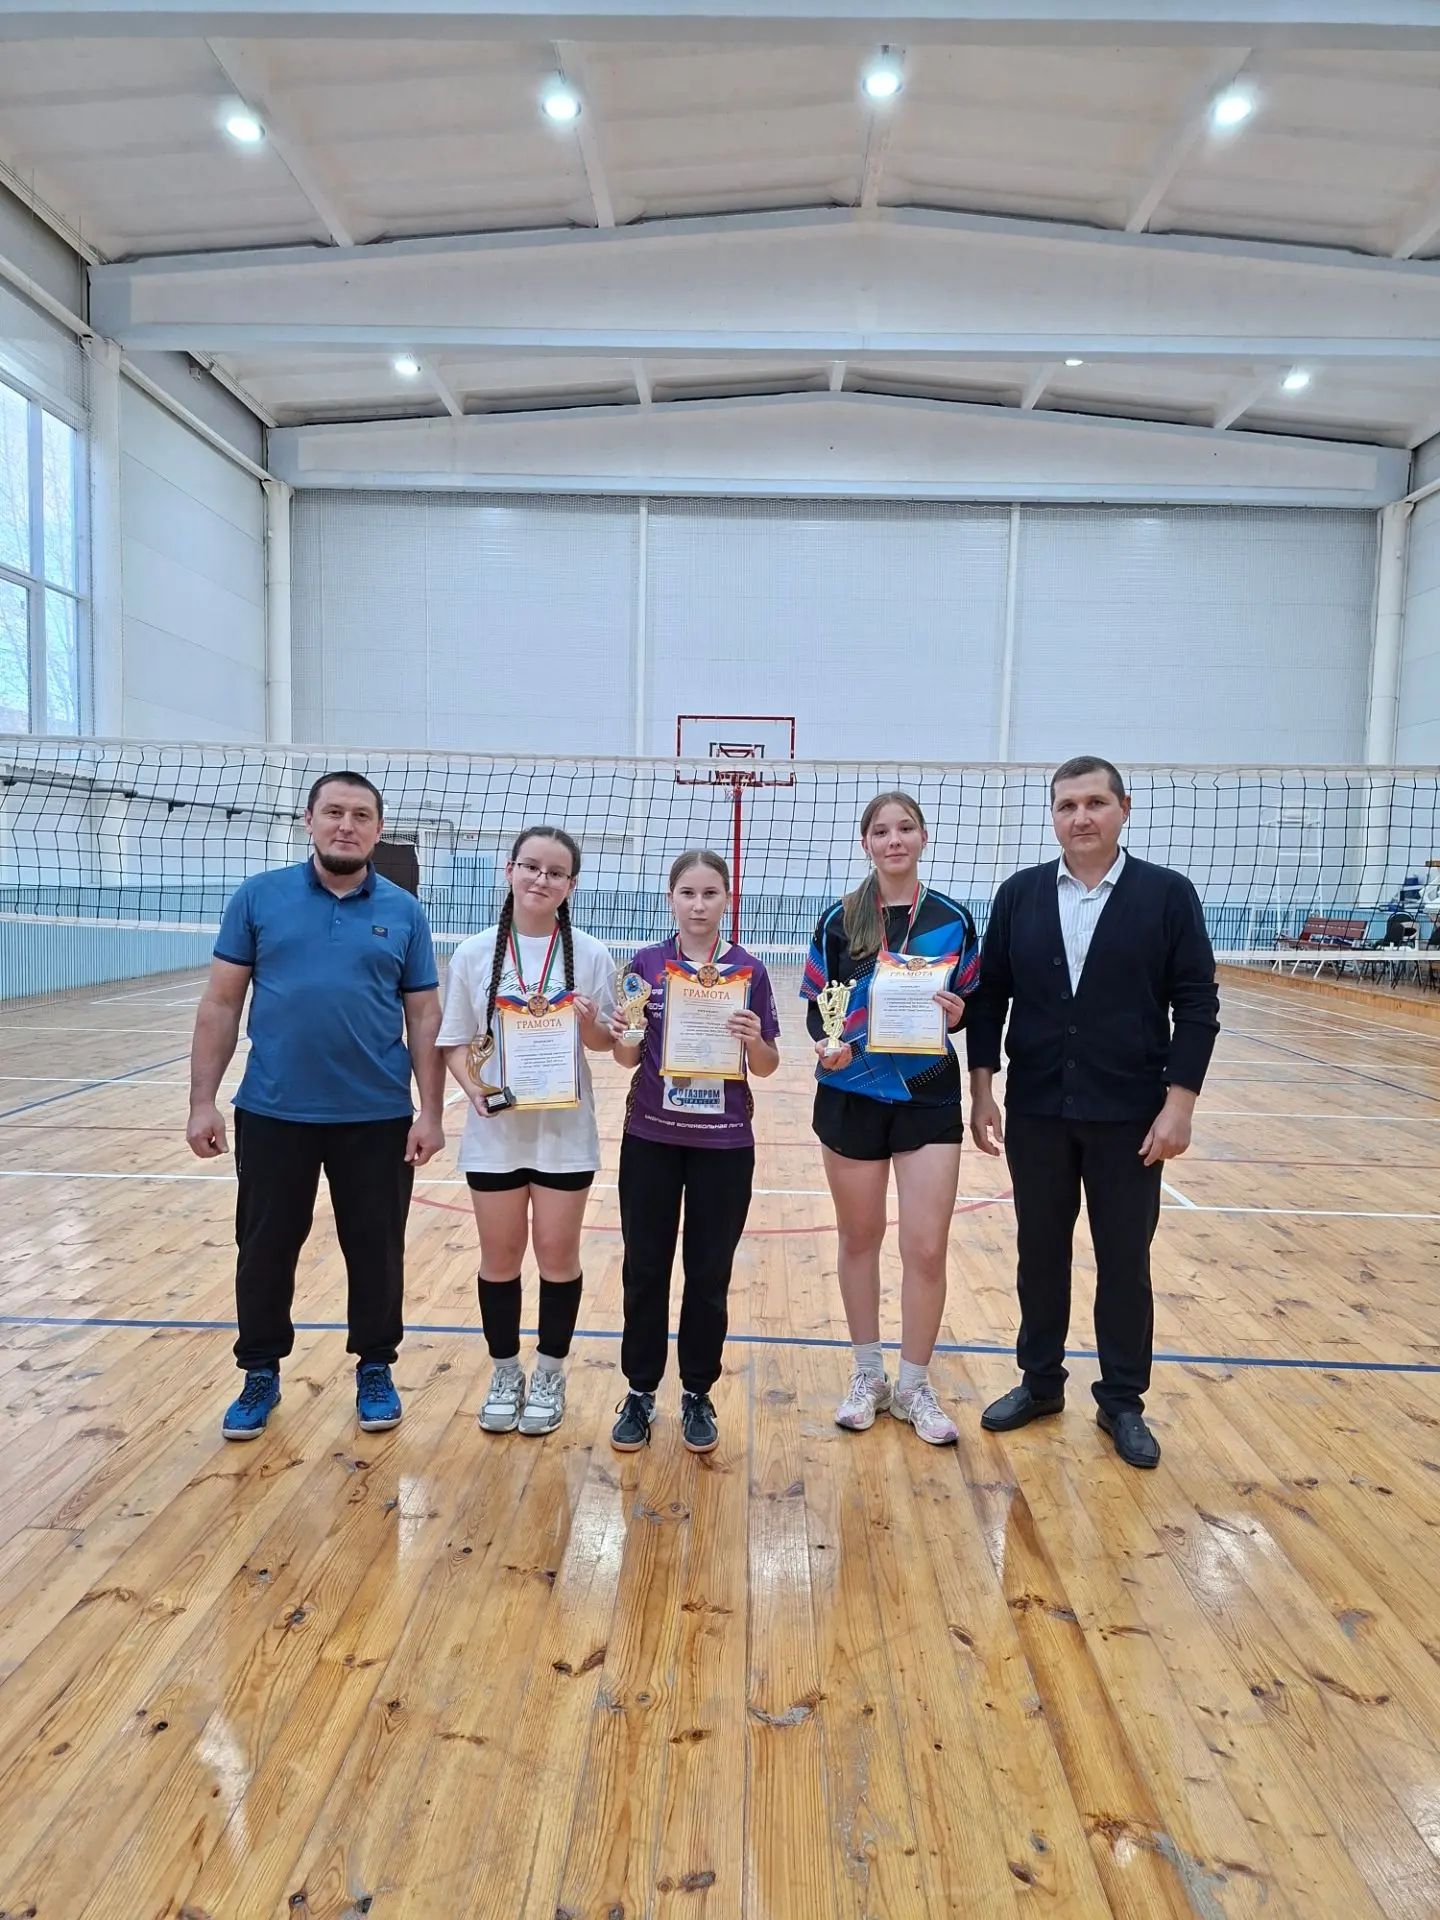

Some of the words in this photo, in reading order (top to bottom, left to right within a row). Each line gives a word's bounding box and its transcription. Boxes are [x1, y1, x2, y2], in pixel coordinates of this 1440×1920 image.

[683, 988, 730, 1000] ГРАМОТА
[516, 1018, 562, 1029] ГРАМОТА
[684, 1089, 720, 1098] ГАЗПРОМ
